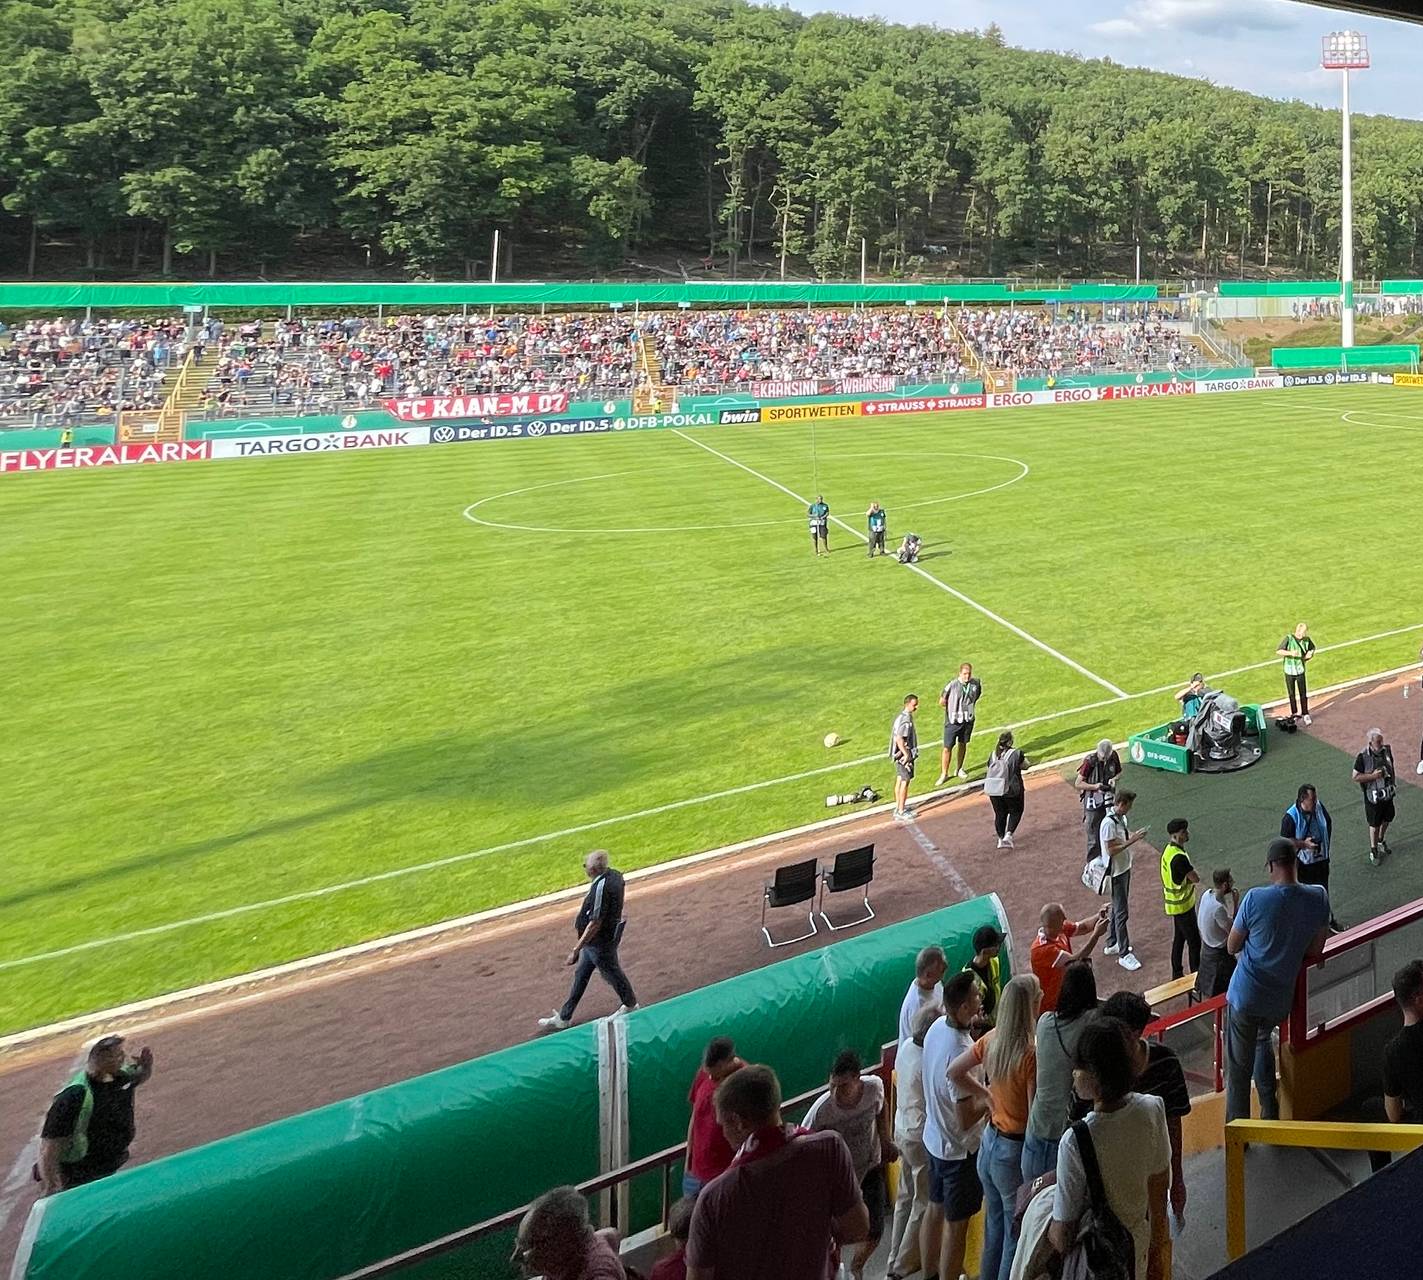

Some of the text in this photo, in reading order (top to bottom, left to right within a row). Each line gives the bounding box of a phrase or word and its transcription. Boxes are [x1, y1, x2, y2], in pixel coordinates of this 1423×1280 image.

[993, 389, 1092, 406] ERGO ERGO
[1112, 382, 1194, 400] FLYERALARM
[397, 401, 426, 419] FC
[538, 394, 564, 413] 07
[877, 397, 983, 412] STRAUSS STRAUSS
[627, 412, 715, 430] DFB-POKAL
[720, 404, 855, 424] bwin SPORTWETTEN
[458, 428, 486, 439] Der
[490, 424, 523, 438] ID.5
[550, 421, 576, 433] Der
[579, 419, 609, 432] ID.5
[0, 442, 208, 472] FLYERALARM
